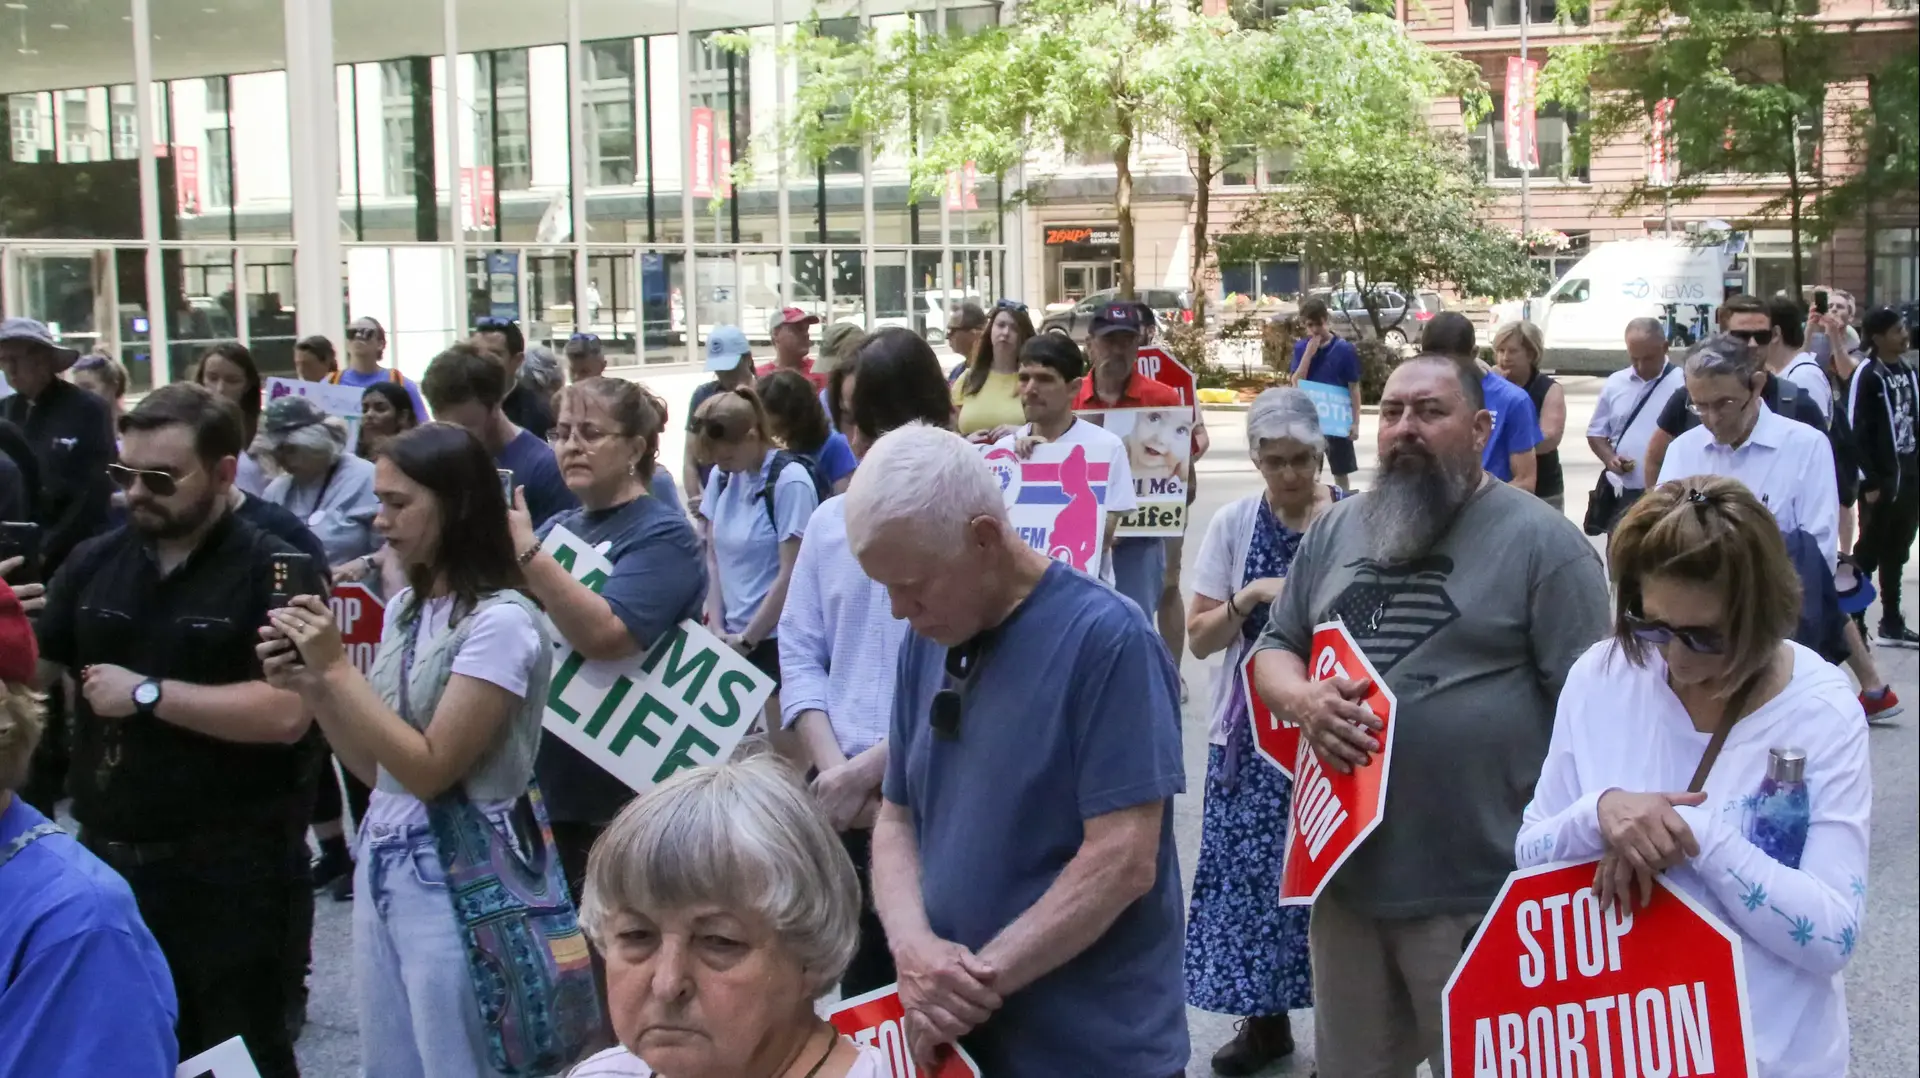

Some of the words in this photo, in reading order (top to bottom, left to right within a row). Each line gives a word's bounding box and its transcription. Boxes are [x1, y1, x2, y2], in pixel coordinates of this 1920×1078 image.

[1652, 283, 1704, 299] NEWS
[1150, 477, 1183, 495] Me.
[1119, 505, 1182, 527] Life!
[1516, 887, 1633, 988] STOP
[1474, 981, 1716, 1078] ABORTION
